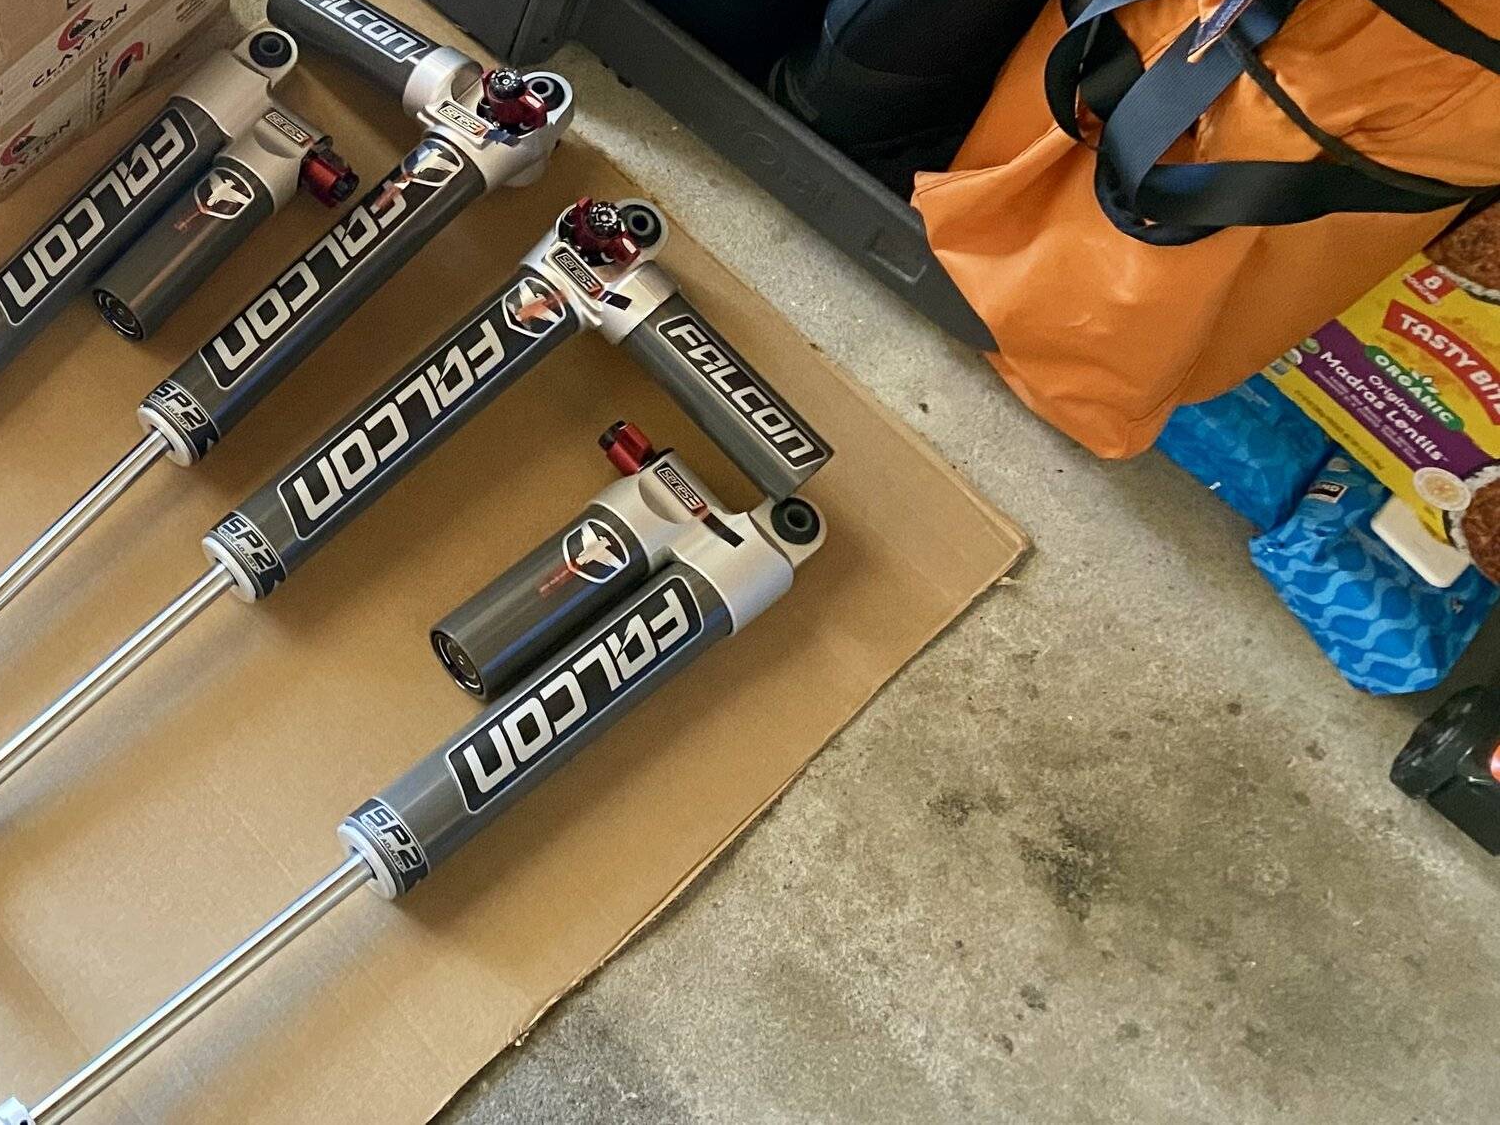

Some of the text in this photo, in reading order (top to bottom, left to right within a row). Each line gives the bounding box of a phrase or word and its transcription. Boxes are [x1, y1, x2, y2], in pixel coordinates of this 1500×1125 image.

[31, 2, 129, 89] CLAYTON
[3, 117, 186, 309] FALCON
[213, 193, 407, 371] FALCON
[1424, 276, 1443, 291] 8
[1400, 312, 1479, 371] TASTY
[154, 383, 208, 427] SP2
[293, 320, 506, 522] FALCON
[668, 324, 816, 459] FALCON
[1320, 351, 1387, 410] Madras
[1386, 410, 1444, 462] Lentils
[1368, 375, 1424, 424] Original
[1374, 354, 1455, 423] ORGANIC
[224, 518, 278, 572] SP2
[464, 588, 691, 795] FALCON
[366, 807, 423, 869] SP2
